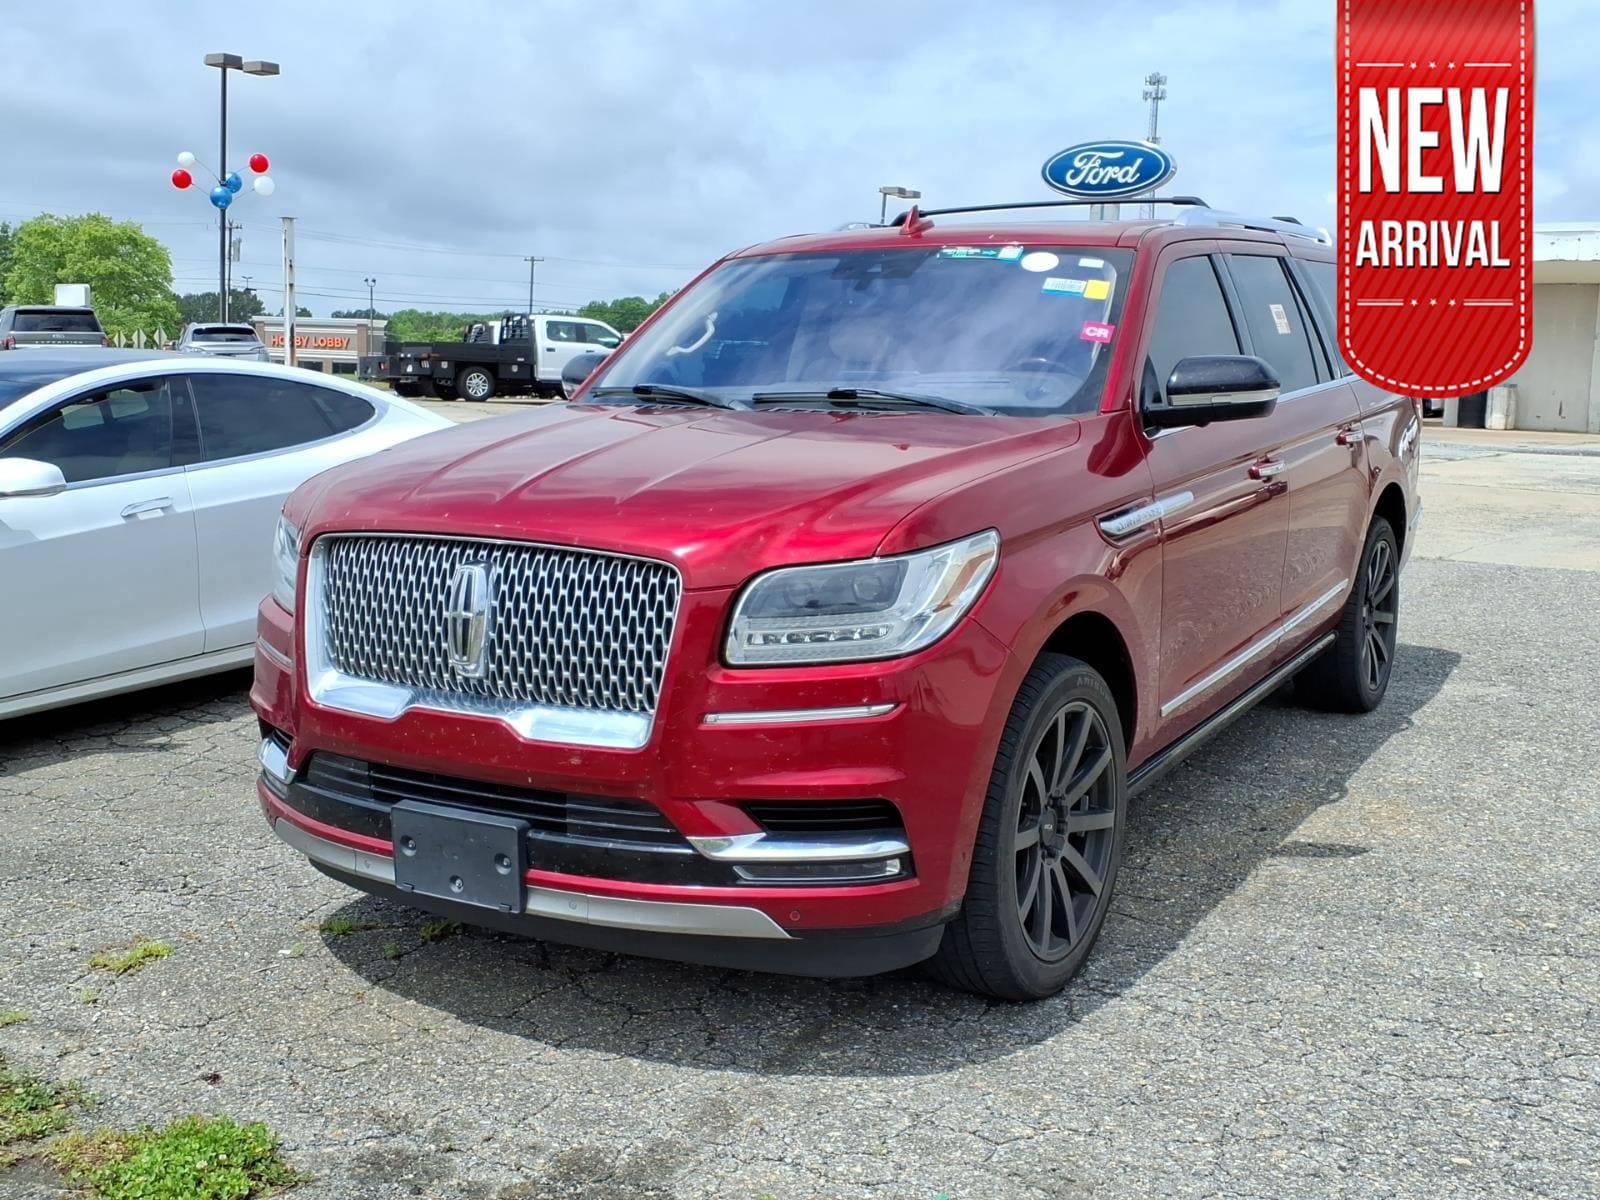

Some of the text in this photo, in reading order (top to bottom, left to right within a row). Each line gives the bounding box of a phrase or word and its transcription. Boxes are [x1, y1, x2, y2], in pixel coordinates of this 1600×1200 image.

[1065, 151, 1144, 186] Ford
[1085, 325, 1110, 339] CR
[271, 335, 350, 349] HOBY LOBBY
